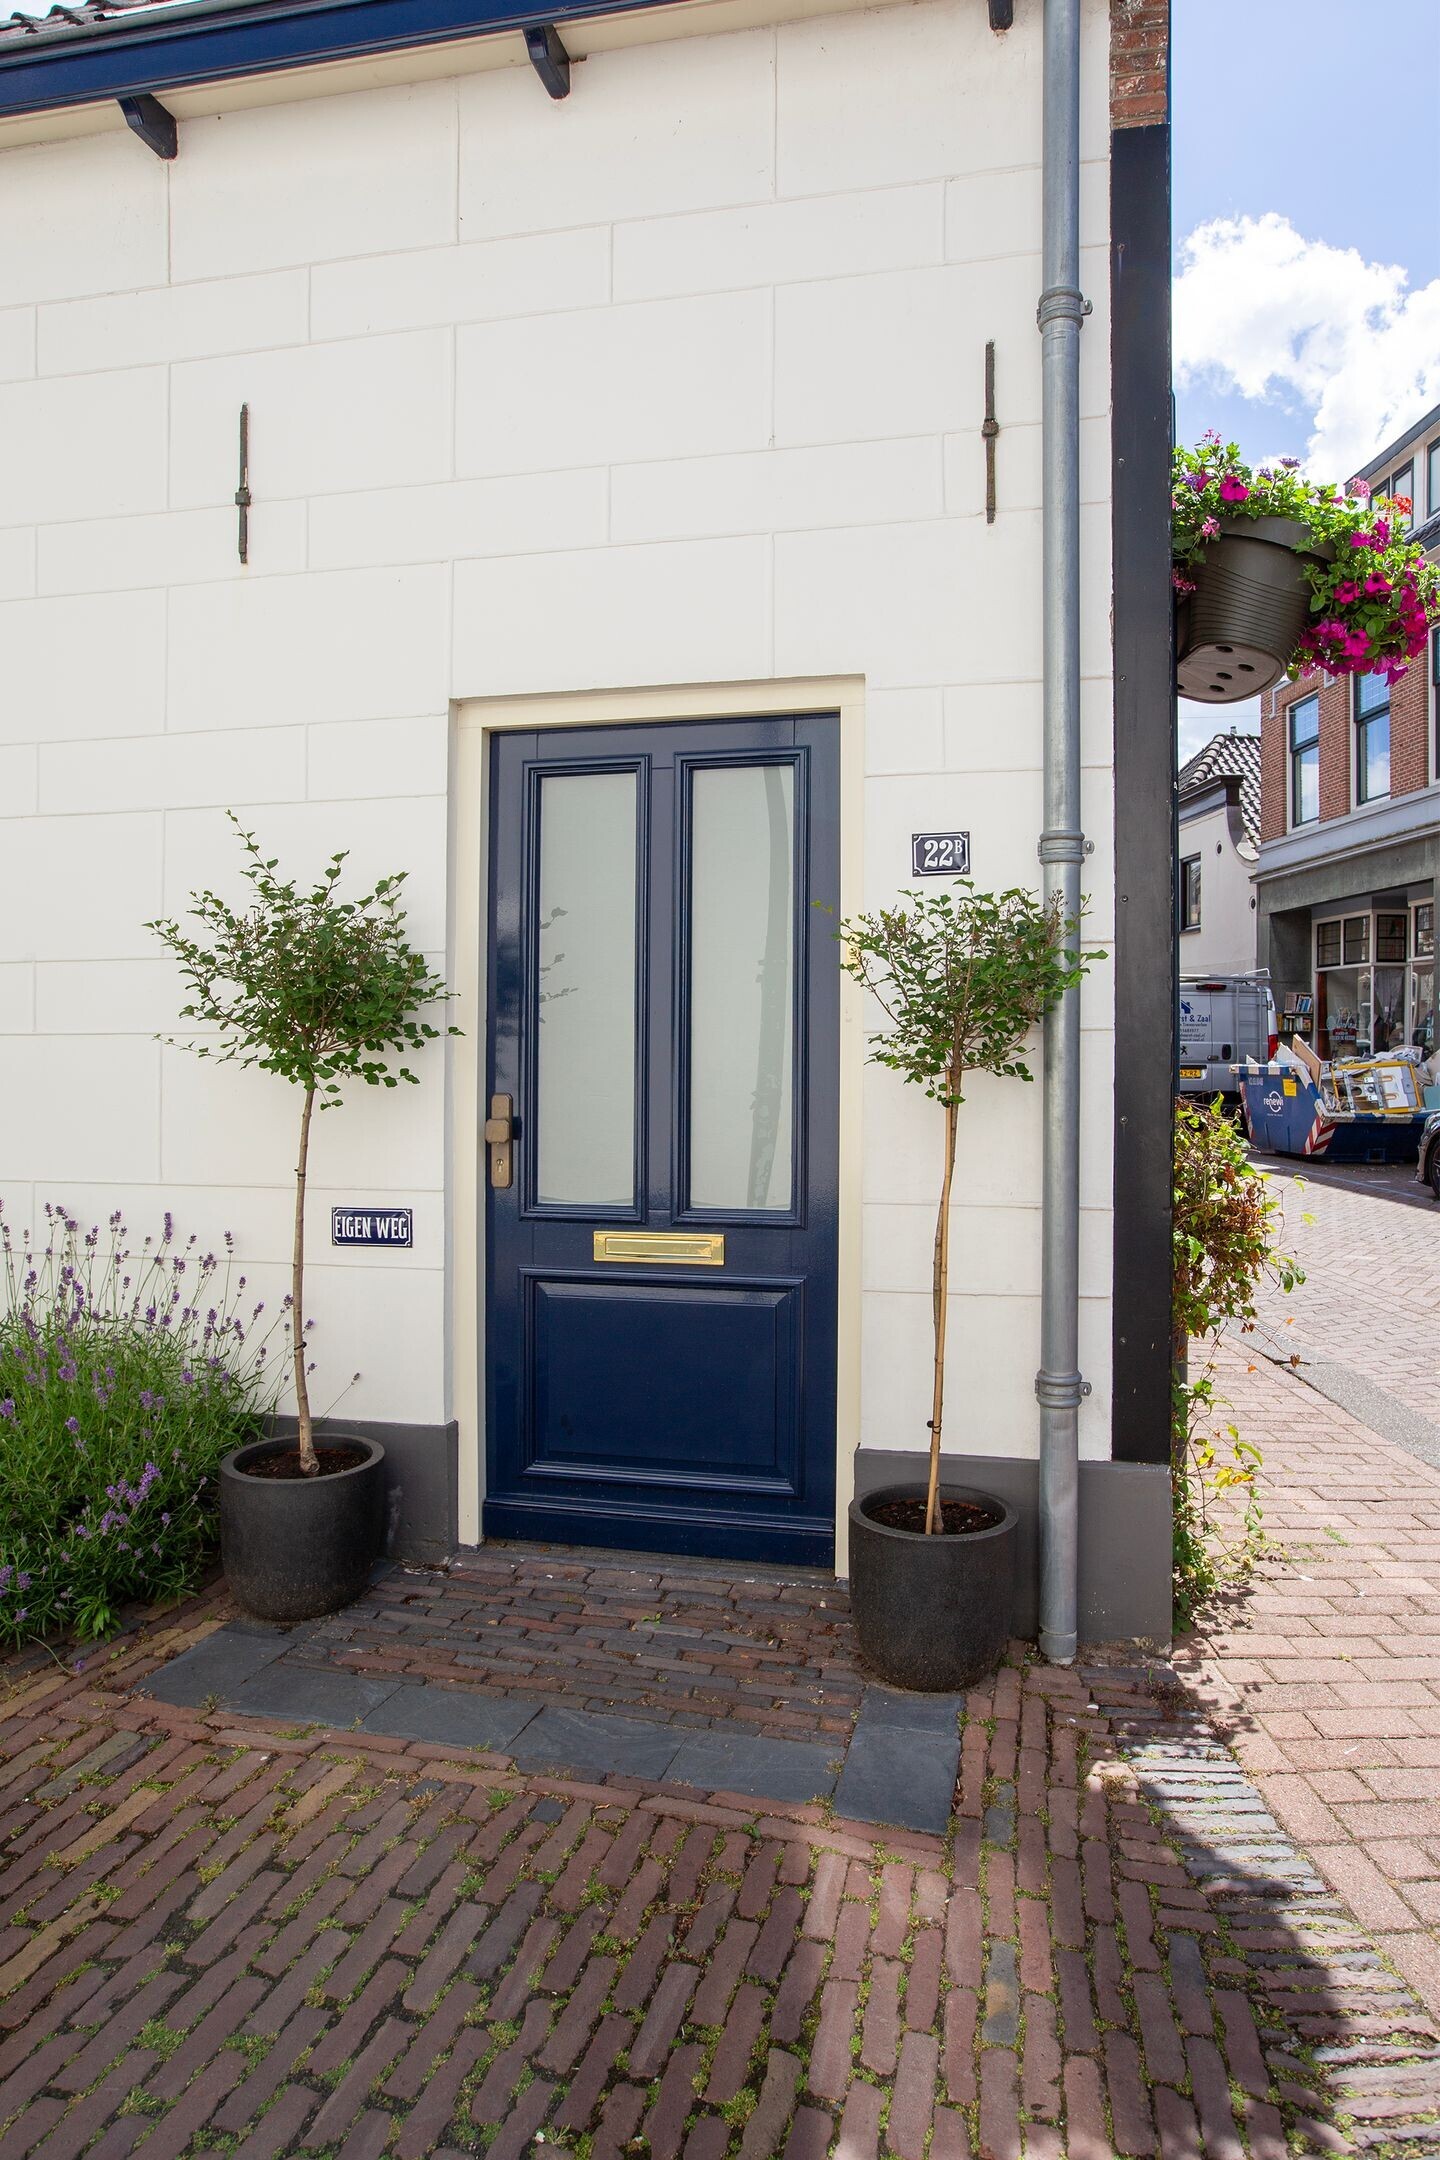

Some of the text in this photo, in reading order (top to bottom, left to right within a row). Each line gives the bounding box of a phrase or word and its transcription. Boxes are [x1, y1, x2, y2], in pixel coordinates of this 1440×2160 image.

[924, 839, 963, 867] 22B
[1189, 1014, 1195, 1022] &
[1197, 1014, 1211, 1023] Zaal
[1263, 1096, 1284, 1106] renewi
[335, 1216, 408, 1239] EIGEN WEG
